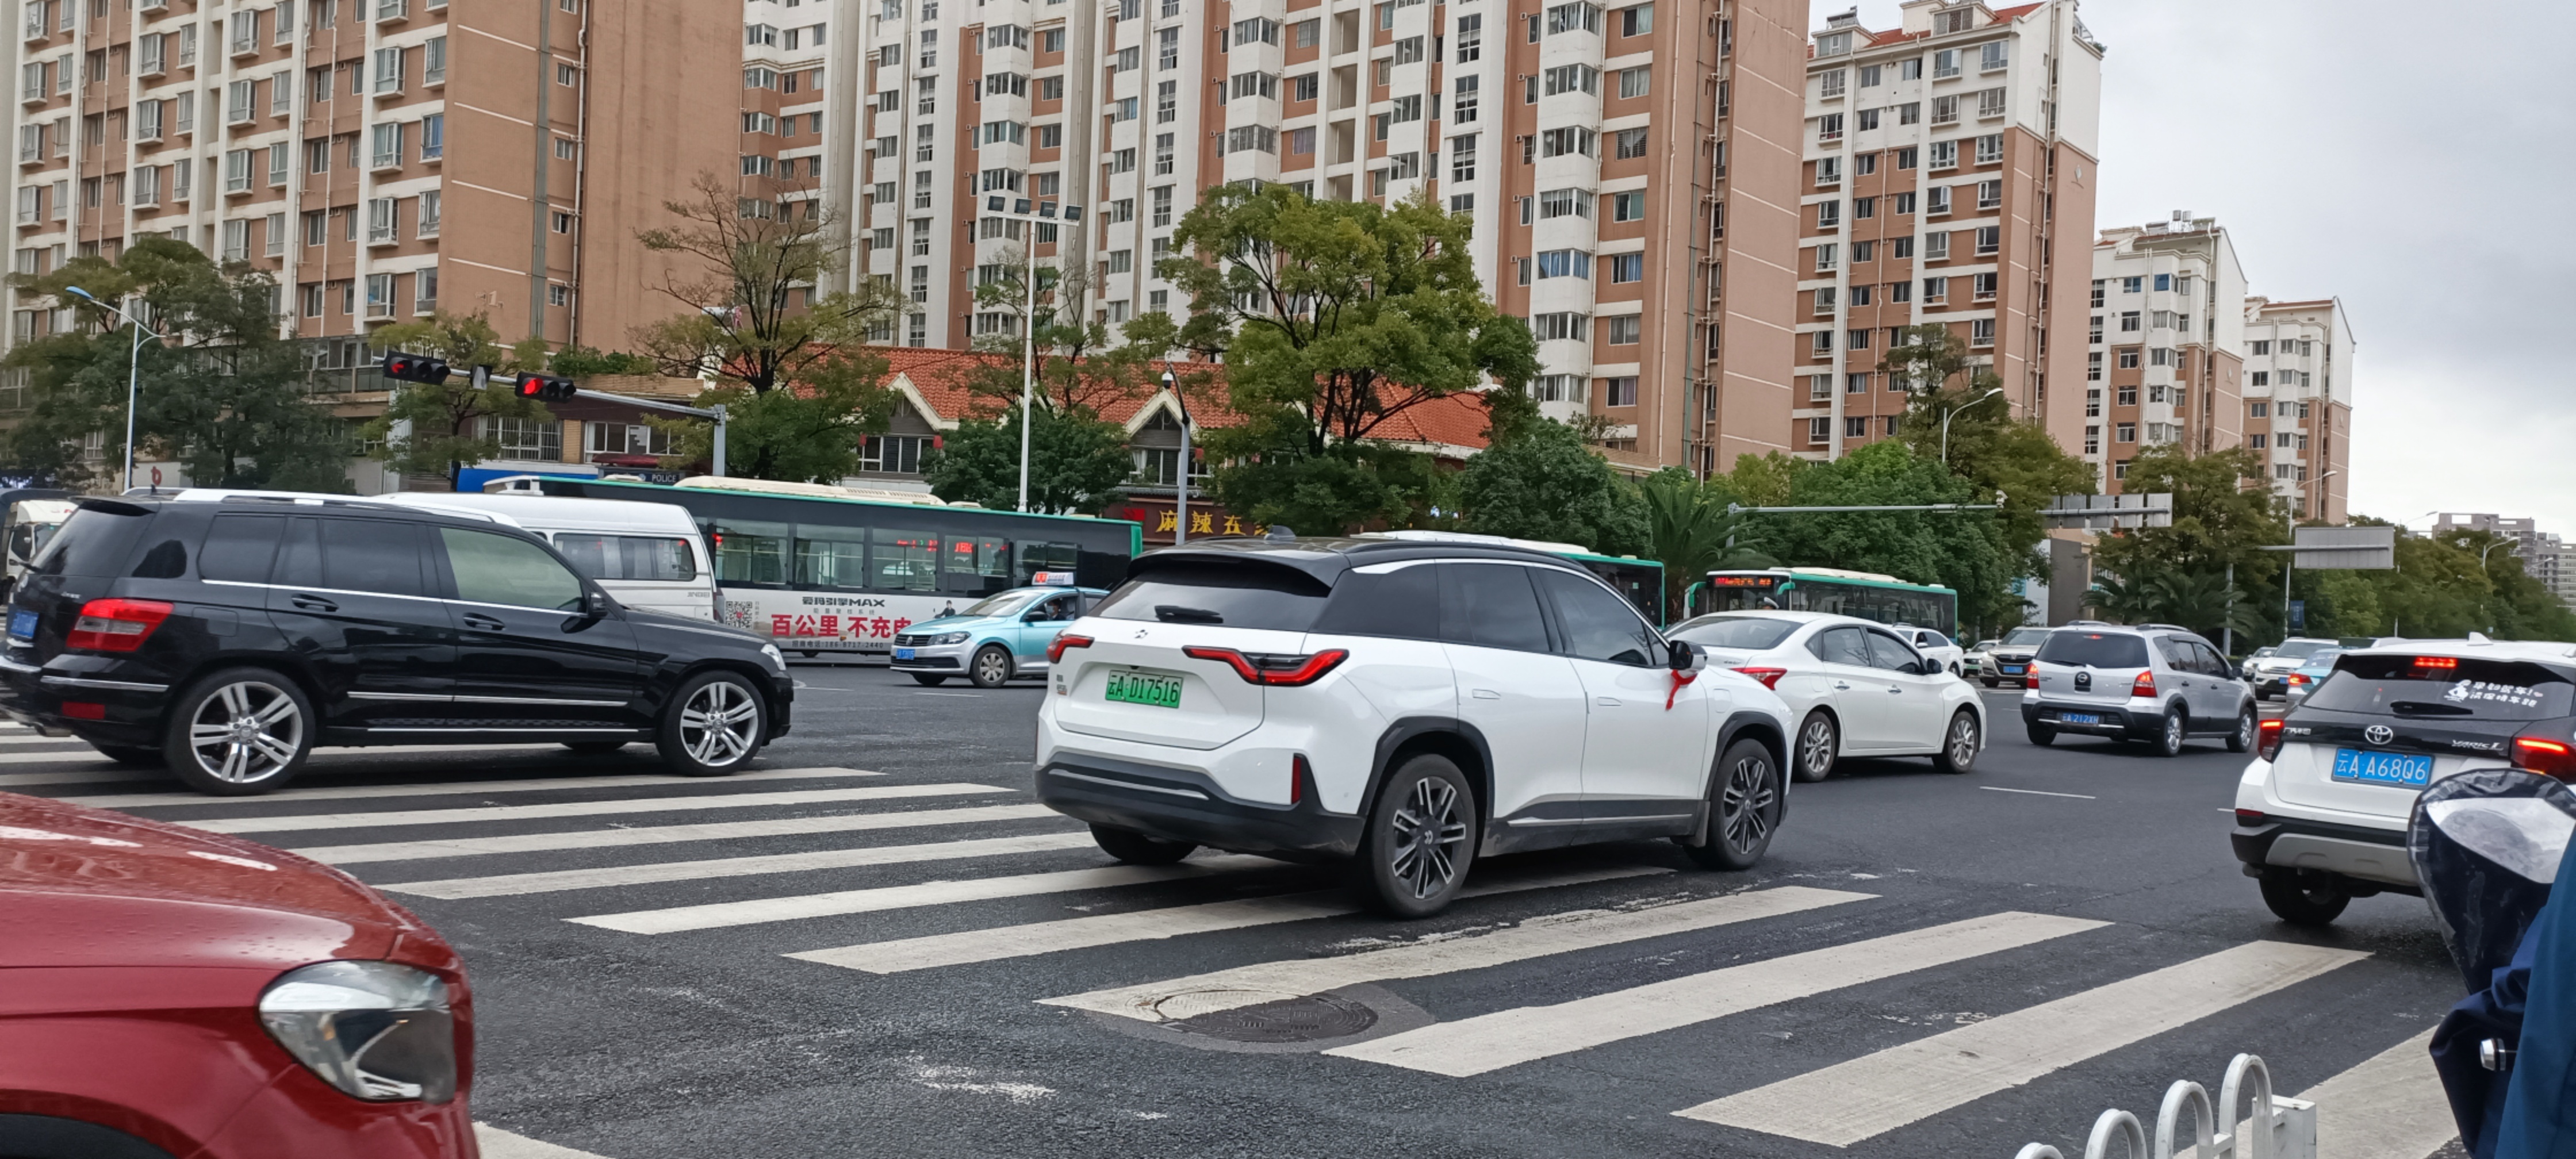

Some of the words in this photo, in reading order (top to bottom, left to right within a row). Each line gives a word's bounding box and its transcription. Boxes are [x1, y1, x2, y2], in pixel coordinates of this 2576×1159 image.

[651, 474, 677, 482] POLICE
[771, 614, 839, 637] 百公里
